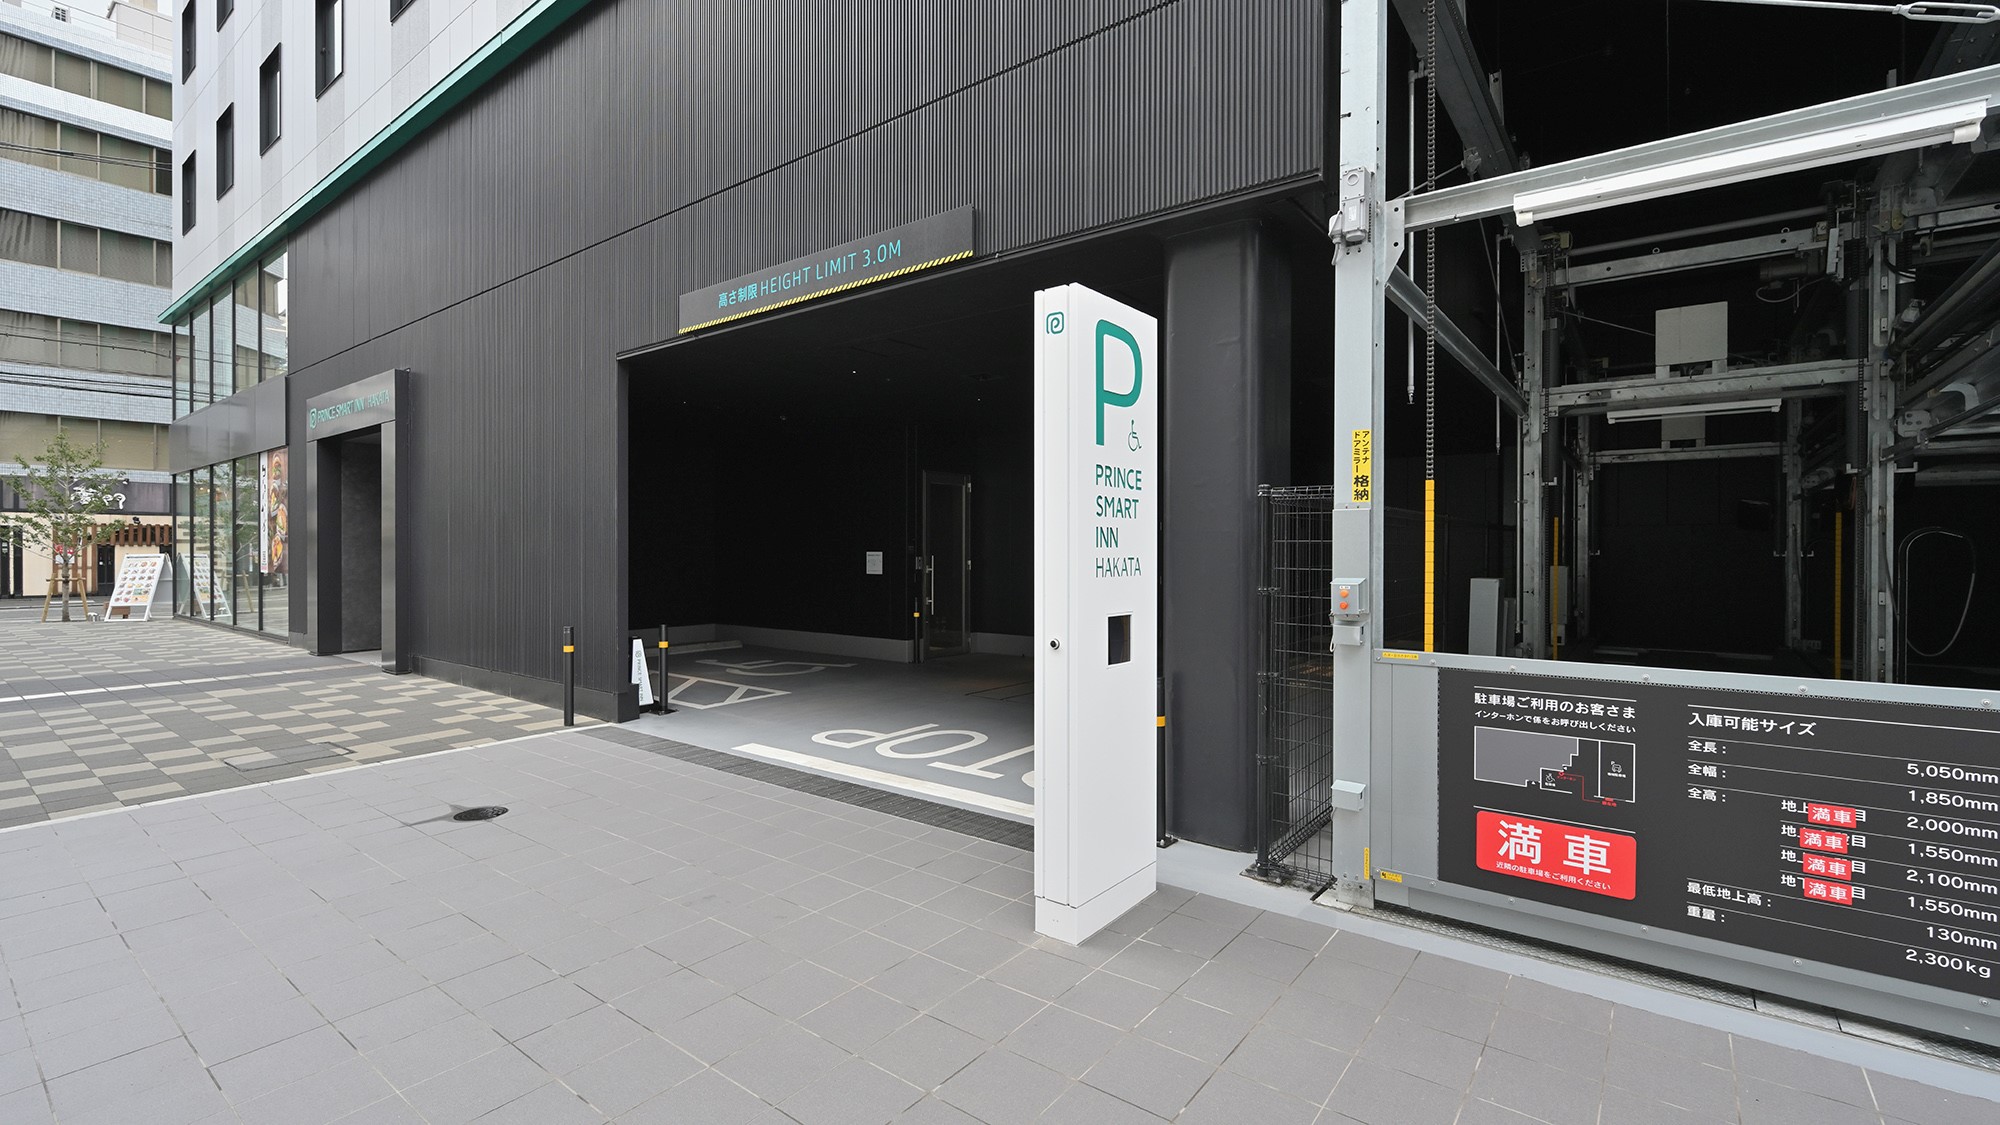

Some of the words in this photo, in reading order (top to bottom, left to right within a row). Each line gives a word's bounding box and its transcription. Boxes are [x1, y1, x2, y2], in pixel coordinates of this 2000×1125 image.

[718, 284, 758, 309] 高さ制限
[760, 267, 811, 297] HEIGHT
[816, 252, 857, 280] LIMIT
[862, 240, 902, 268] 3.0M
[1095, 319, 1143, 446] P
[317, 405, 336, 423] PRINCE
[336, 399, 354, 418] SMART
[354, 396, 365, 413] INN
[367, 389, 390, 408] HAKATA
[1353, 431, 1361, 473] ドアミラー
[1362, 431, 1370, 464] アンテナ
[1095, 463, 1142, 491] PRINCE
[1353, 475, 1370, 501] 格納
[1095, 495, 1140, 520] SMART
[1095, 527, 1119, 549] INN
[1095, 556, 1142, 578] HAKATA
[1474, 692, 1636, 719] 駐車場ご利用のお客さま
[1474, 709, 1636, 734] インターホンで係をお呼び出しください
[1688, 712, 1817, 736] 入庫可能サイズ
[1906, 763, 1999, 784] 5,050mm
[1908, 790, 1999, 812] 1,850mm
[1812, 807, 1852, 824] 満車
[1906, 816, 1999, 840] 2,000mm
[1497, 820, 1612, 876] 満車
[1804, 832, 1844, 850] 満車
[1807, 858, 1847, 876] 満車
[1908, 843, 1999, 868] 1,550mm
[1495, 860, 1612, 890] 近隣の駐車場をご利用ください
[1906, 869, 1998, 895] 2,100mm
[1808, 881, 1848, 901] 満車
[1907, 896, 1998, 923] 1,550mm
[1926, 926, 1998, 951] 130mm
[1905, 949, 1992, 979] 2,300kg
